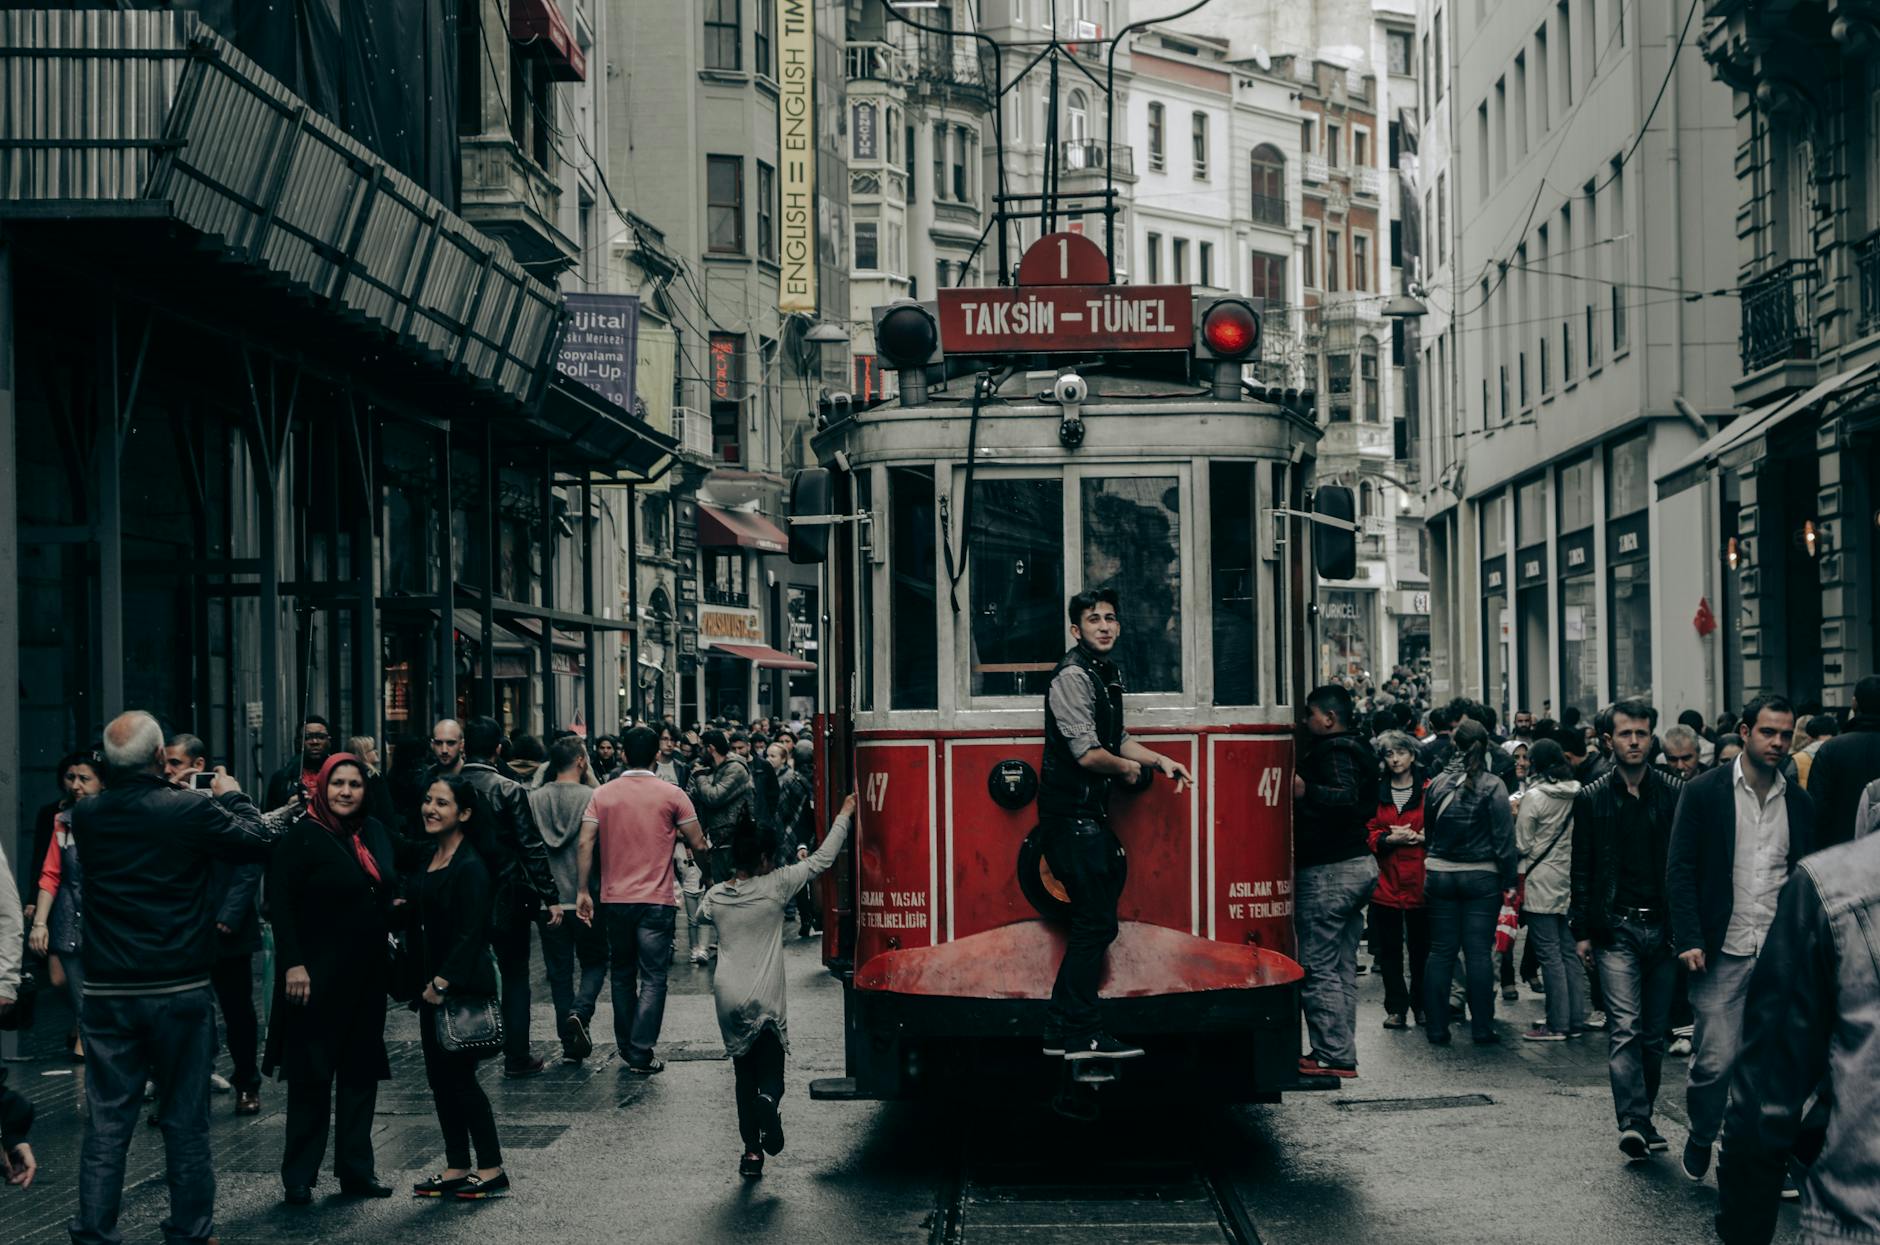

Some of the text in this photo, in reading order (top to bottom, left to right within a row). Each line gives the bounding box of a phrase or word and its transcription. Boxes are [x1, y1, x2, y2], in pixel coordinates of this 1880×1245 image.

[785, 49, 806, 150] ENGLISH
[785, 193, 807, 295] ENGLISH
[1056, 238, 1069, 280] 1
[570, 311, 626, 331] ijital
[960, 294, 1054, 336] TAKSİM
[1086, 294, 1175, 334] TÜNEL
[586, 333, 624, 345] Merkezi
[556, 361, 621, 381] Roll-Up
[866, 772, 889, 812] 47
[1257, 767, 1282, 807] 47
[890, 891, 926, 907] YASAK
[1228, 880, 1272, 898] ASILMAK
[1228, 903, 1245, 919] VE
